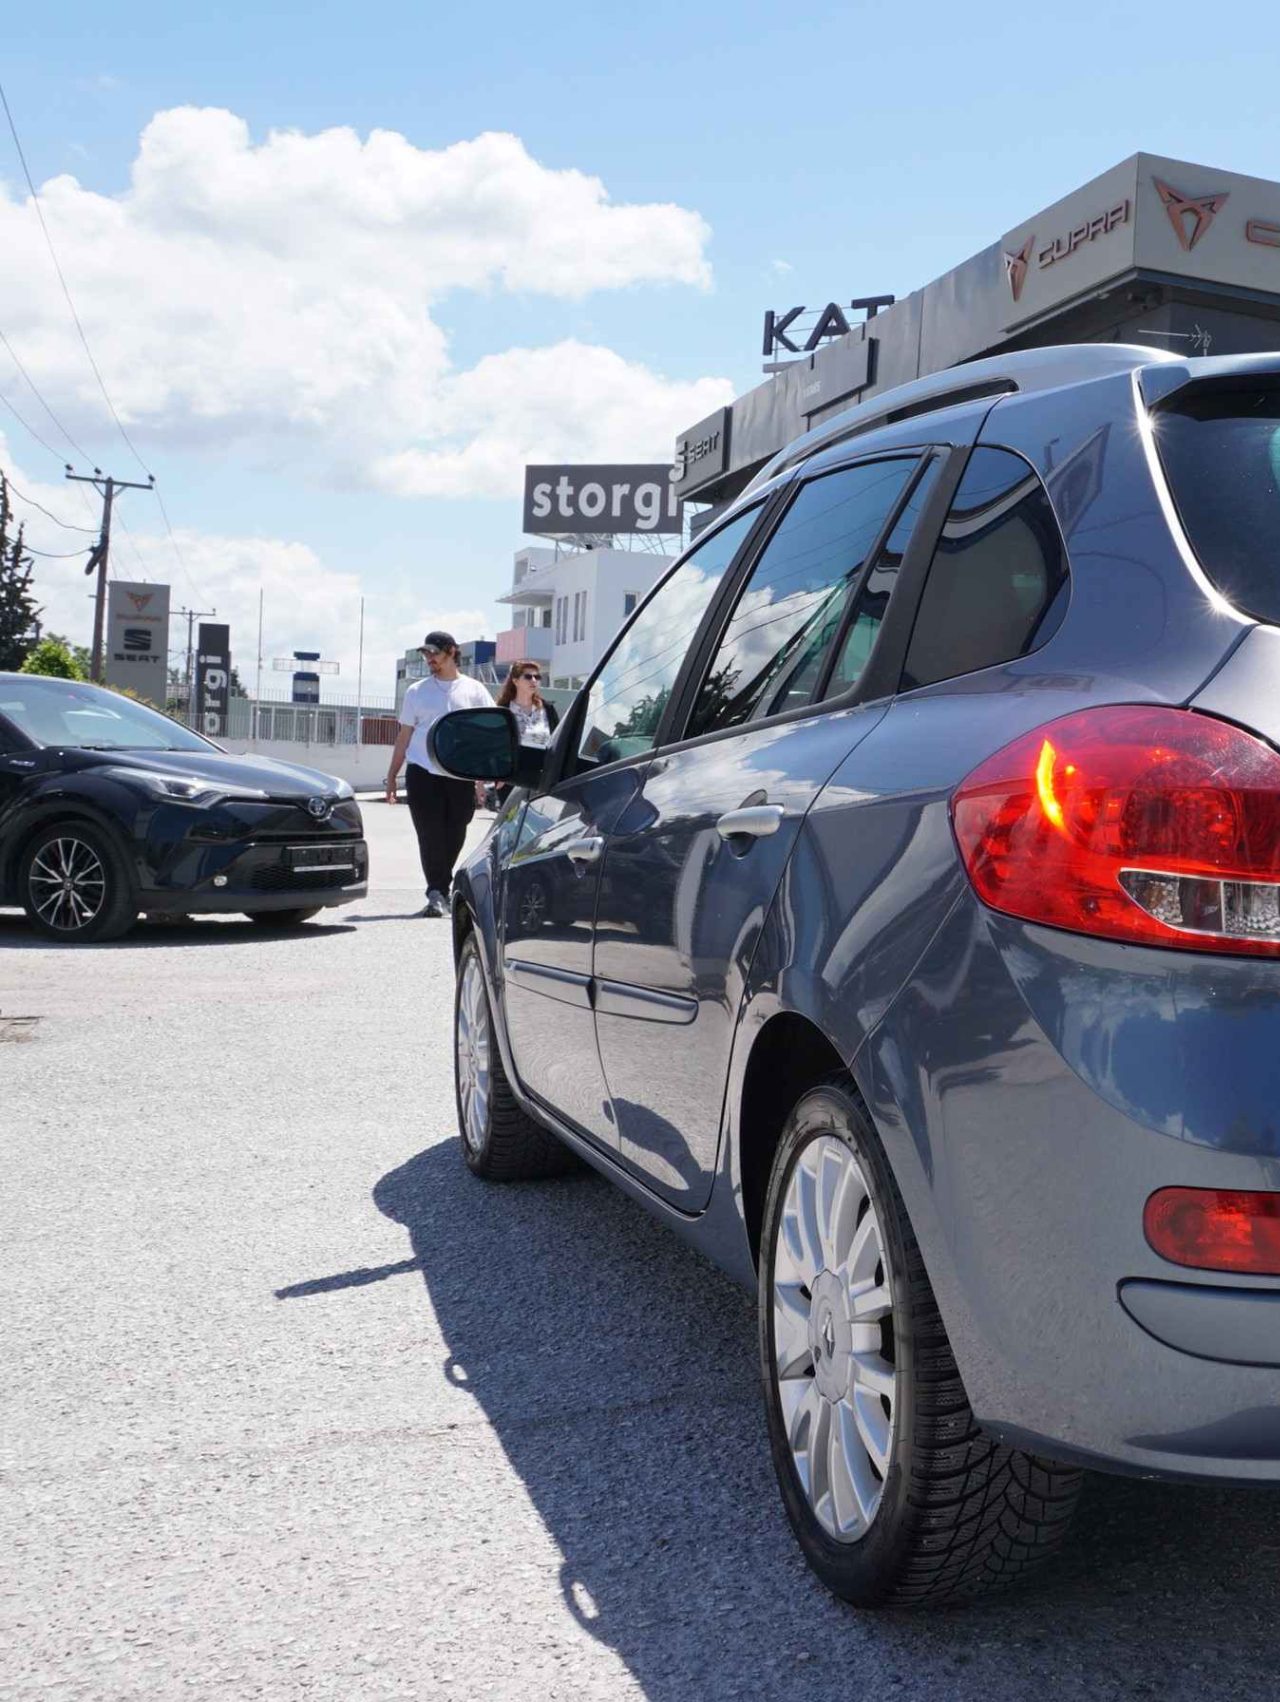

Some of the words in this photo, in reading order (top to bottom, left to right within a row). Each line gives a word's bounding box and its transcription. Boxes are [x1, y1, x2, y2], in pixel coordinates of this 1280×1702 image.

[1038, 200, 1129, 269] CUPRA
[688, 431, 720, 464] SEAT
[113, 653, 160, 664] SEAT
